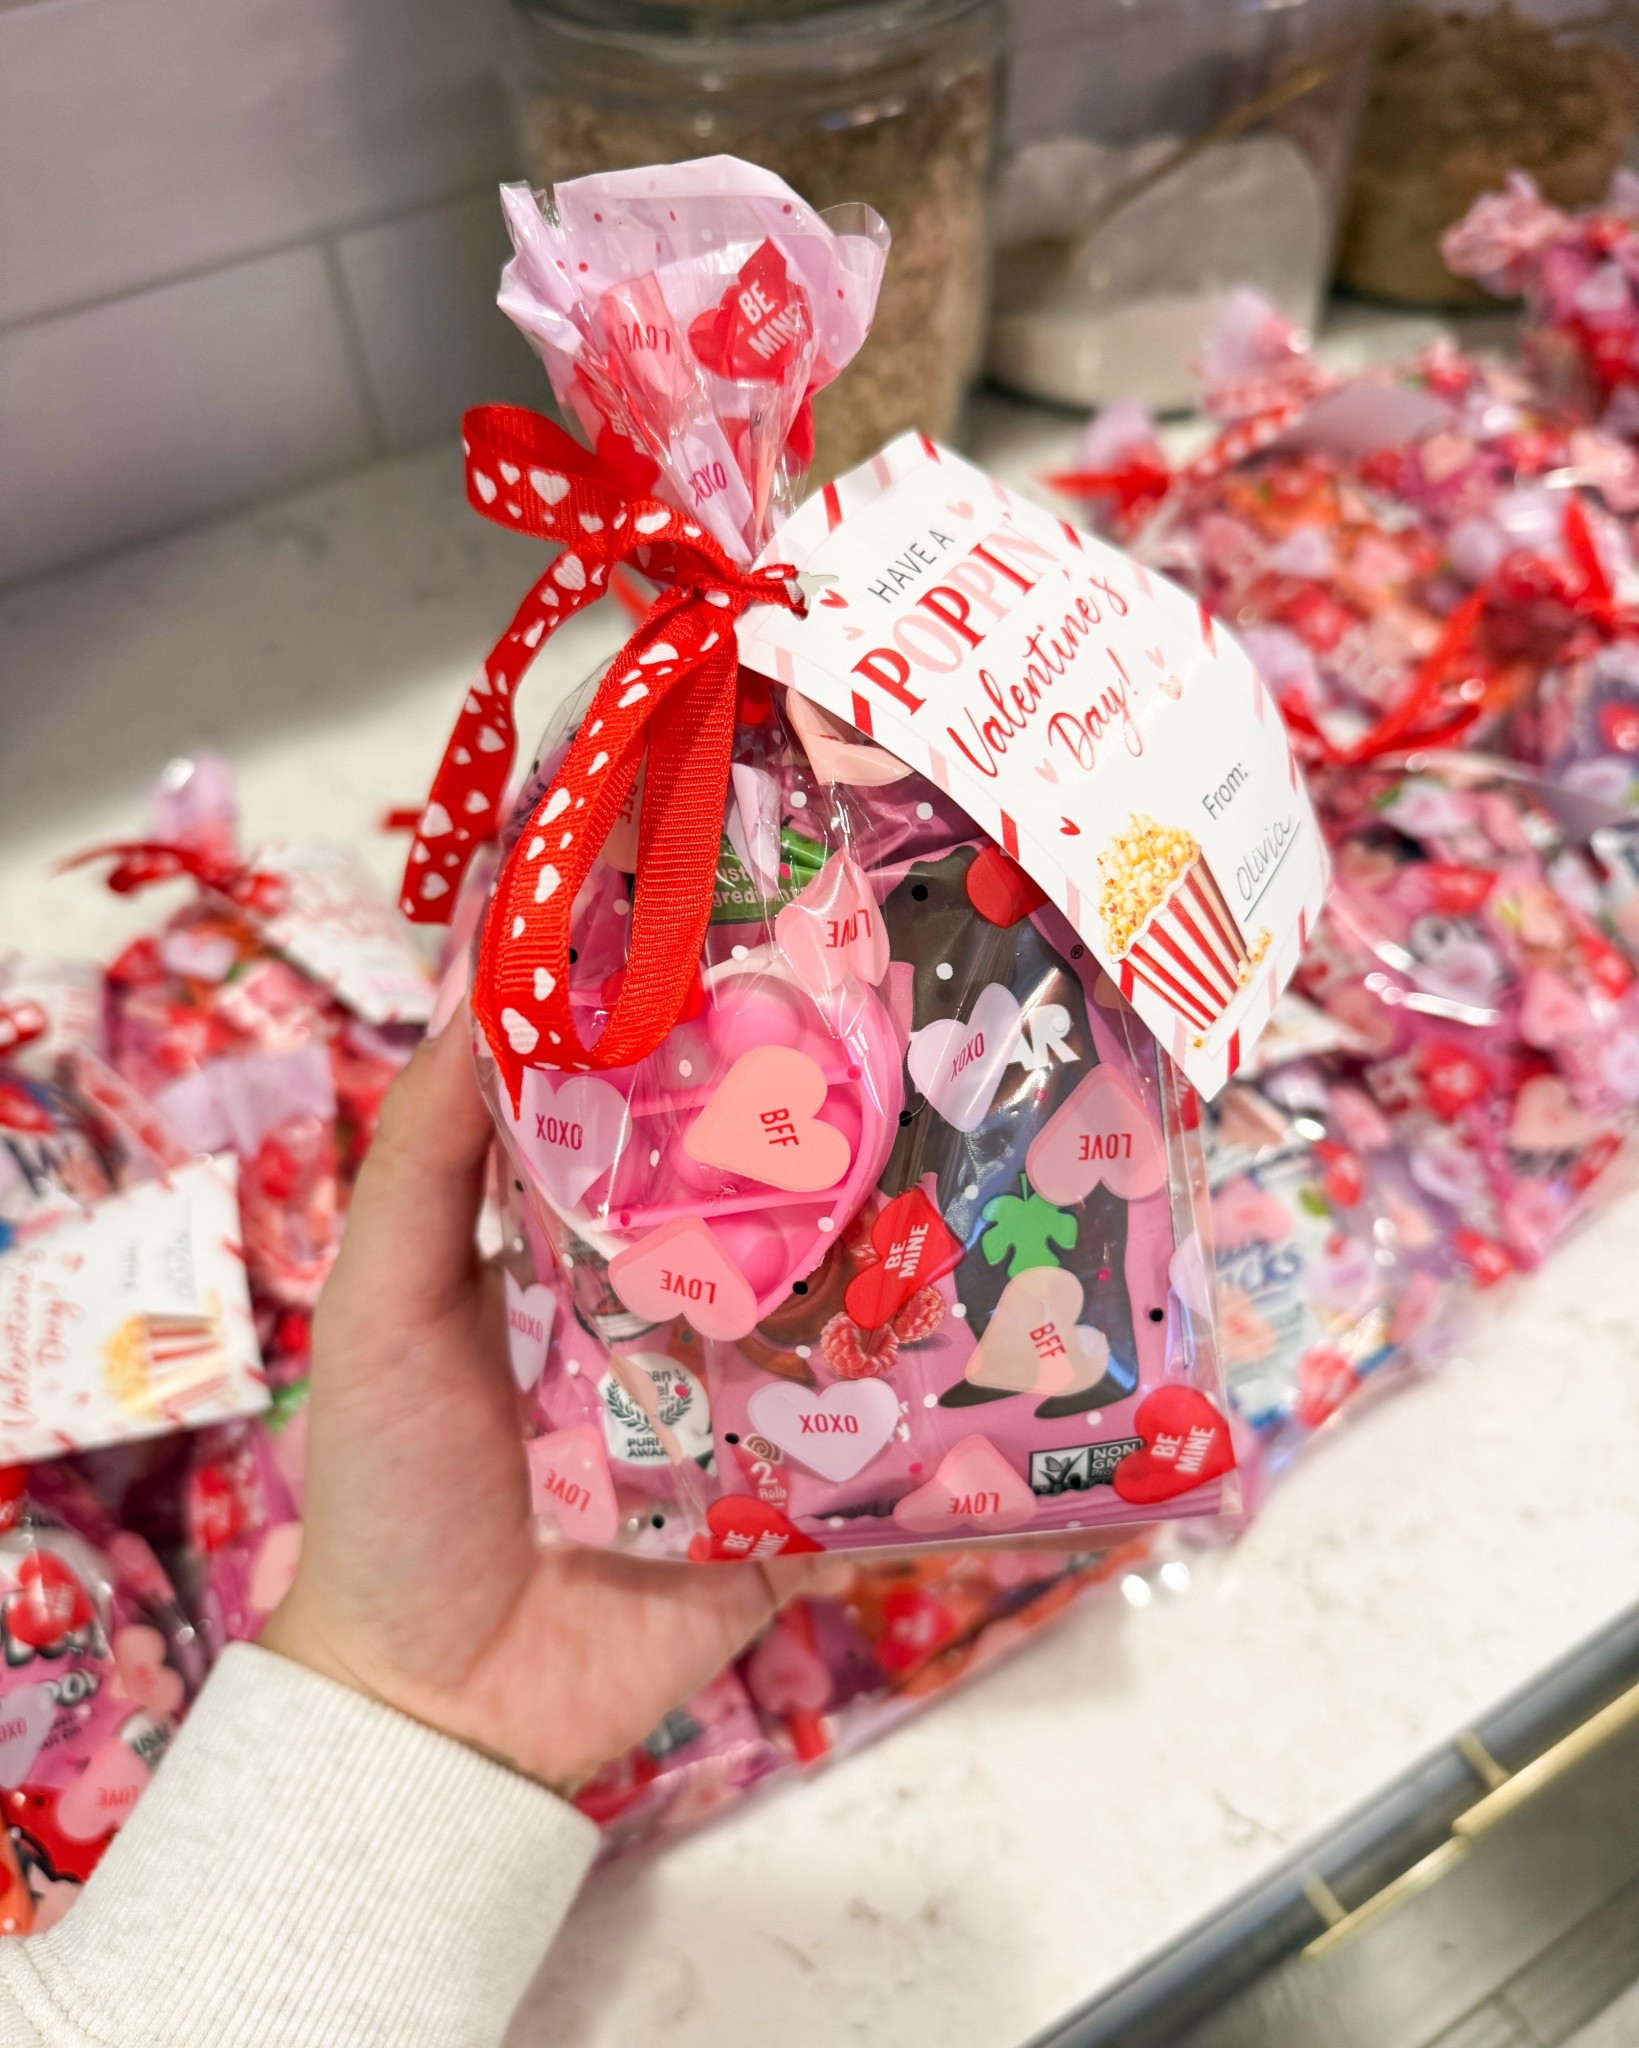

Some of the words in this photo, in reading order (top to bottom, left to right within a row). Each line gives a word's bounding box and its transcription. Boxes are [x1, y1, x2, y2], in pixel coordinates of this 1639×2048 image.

[739, 281, 775, 325] BE
[688, 462, 728, 507] XOXO
[867, 543, 937, 604] HAVE
[928, 530, 955, 551] A
[946, 569, 1128, 778] Valentine's
[1048, 647, 1143, 771] Day!
[1202, 762, 1249, 821] From:
[1237, 816, 1291, 901] Olivia
[826, 909, 872, 948] LOVE
[951, 1032, 985, 1082] XOXO
[536, 1113, 583, 1150] XOXO
[759, 1108, 799, 1147] BFF
[1078, 1133, 1132, 1161] LOVE
[885, 1240, 906, 1269] BE
[898, 1222, 929, 1279] MINE
[660, 1269, 716, 1304] LOVE
[511, 1307, 544, 1343] XOXO
[1029, 1322, 1066, 1359] BFF
[627, 1437, 660, 1447] PURI
[799, 1413, 859, 1434] XOXO
[1092, 1457, 1121, 1470] GM
[1151, 1433, 1182, 1458] BE
[1174, 1426, 1215, 1473] MINE
[544, 1469, 591, 1513] LOVE
[751, 1461, 778, 1485] 2
[947, 1491, 1000, 1515] LOVE
[722, 1530, 755, 1550] BE
